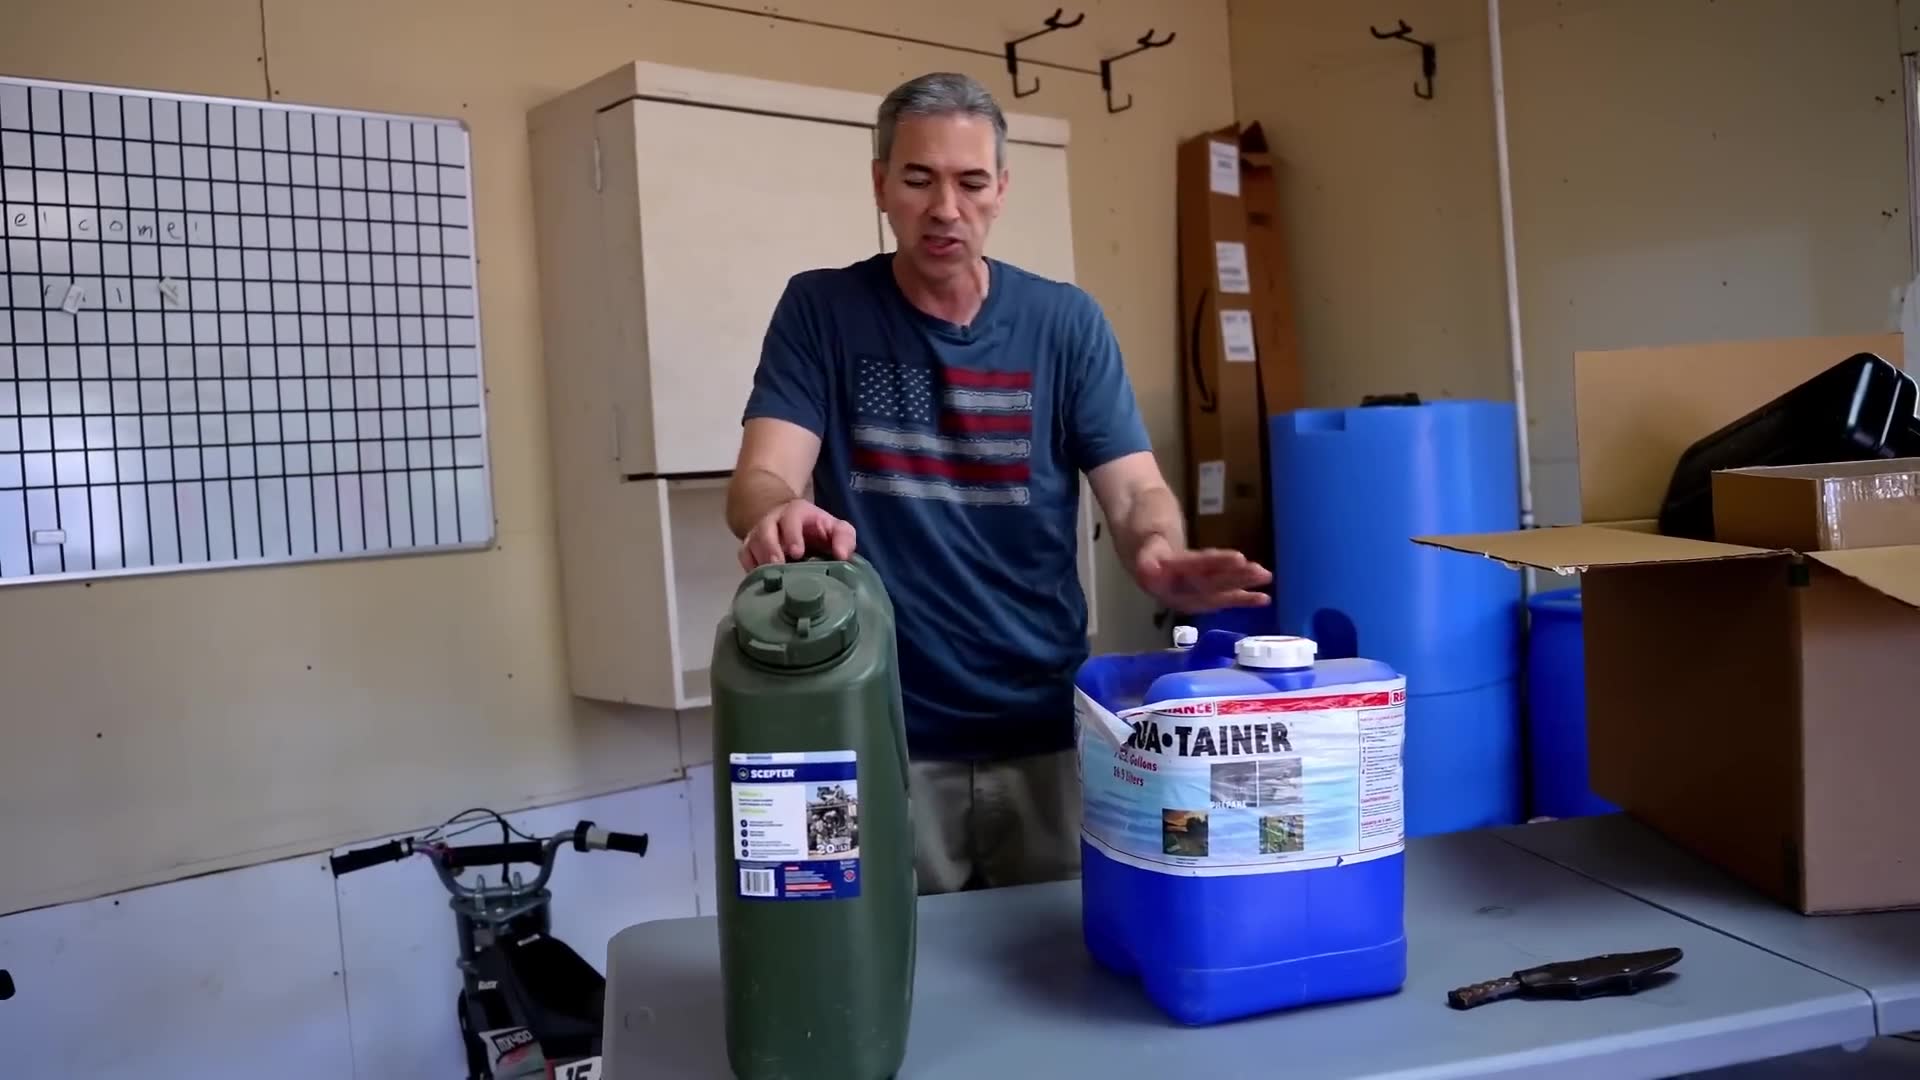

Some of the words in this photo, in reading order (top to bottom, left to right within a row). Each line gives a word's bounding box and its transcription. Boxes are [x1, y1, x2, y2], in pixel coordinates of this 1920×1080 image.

[1393, 692, 1406, 703] RE
[750, 768, 795, 779] SCEPTER
[816, 844, 835, 854] 20
